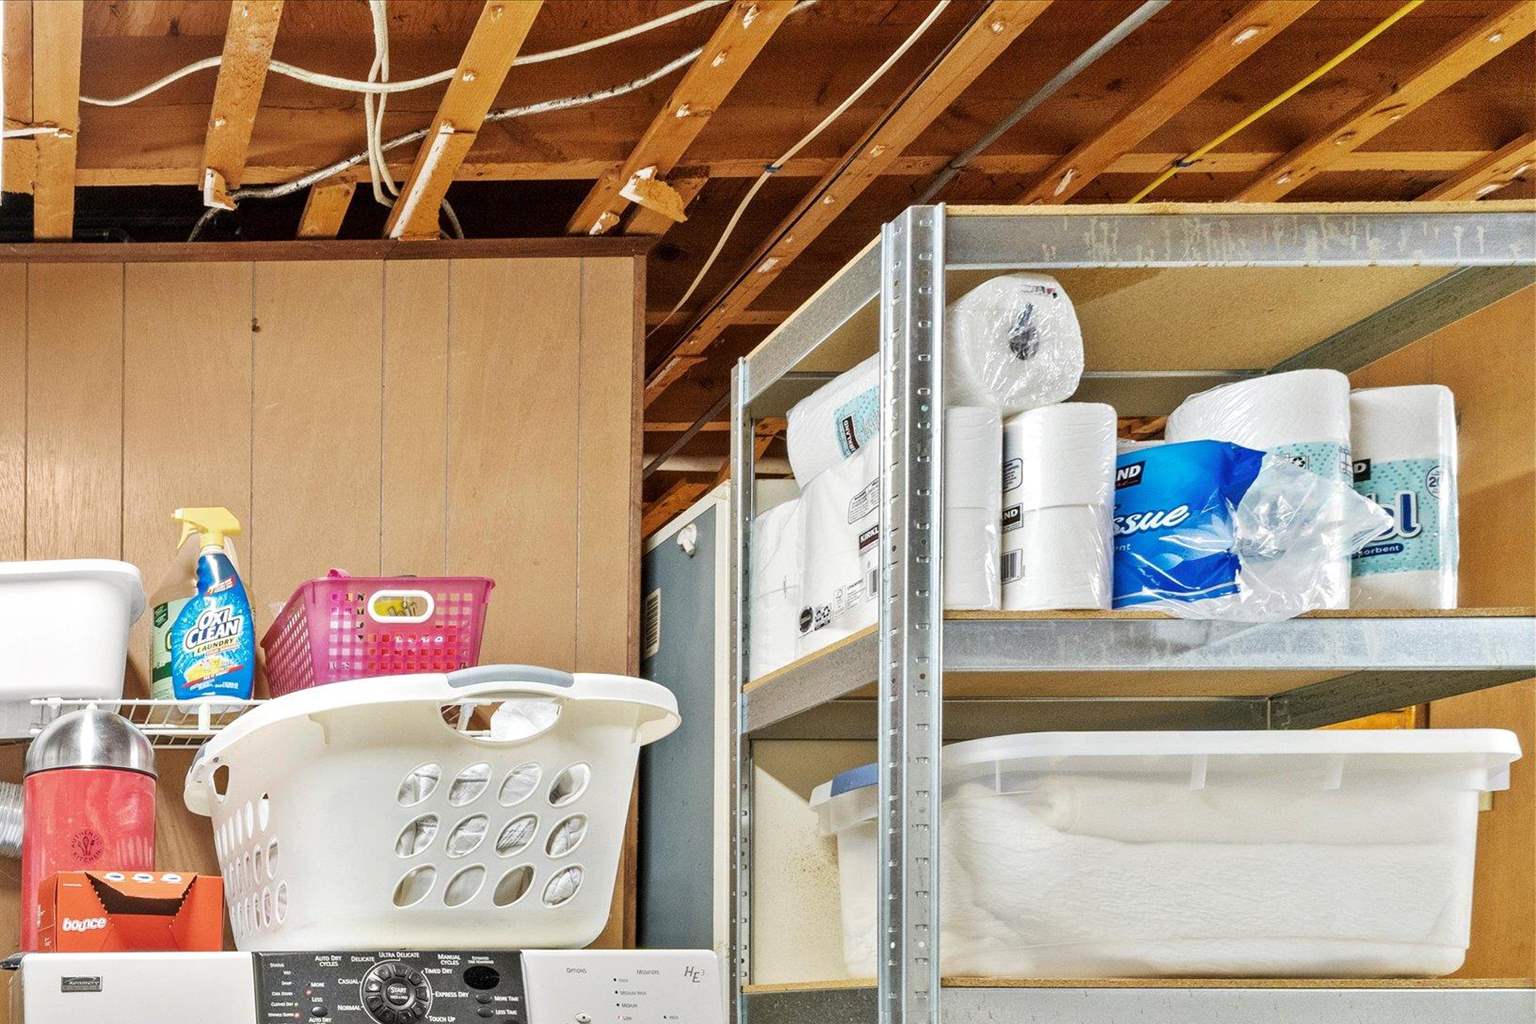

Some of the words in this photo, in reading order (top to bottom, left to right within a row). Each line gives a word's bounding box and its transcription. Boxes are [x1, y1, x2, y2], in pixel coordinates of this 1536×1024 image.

[1114, 505, 1191, 535] ssue
[1359, 545, 1400, 556] sorbent
[197, 607, 231, 631] OXI
[185, 618, 241, 650] CLEAN
[197, 638, 235, 653] LAUNDRY
[63, 918, 107, 931] bounce
